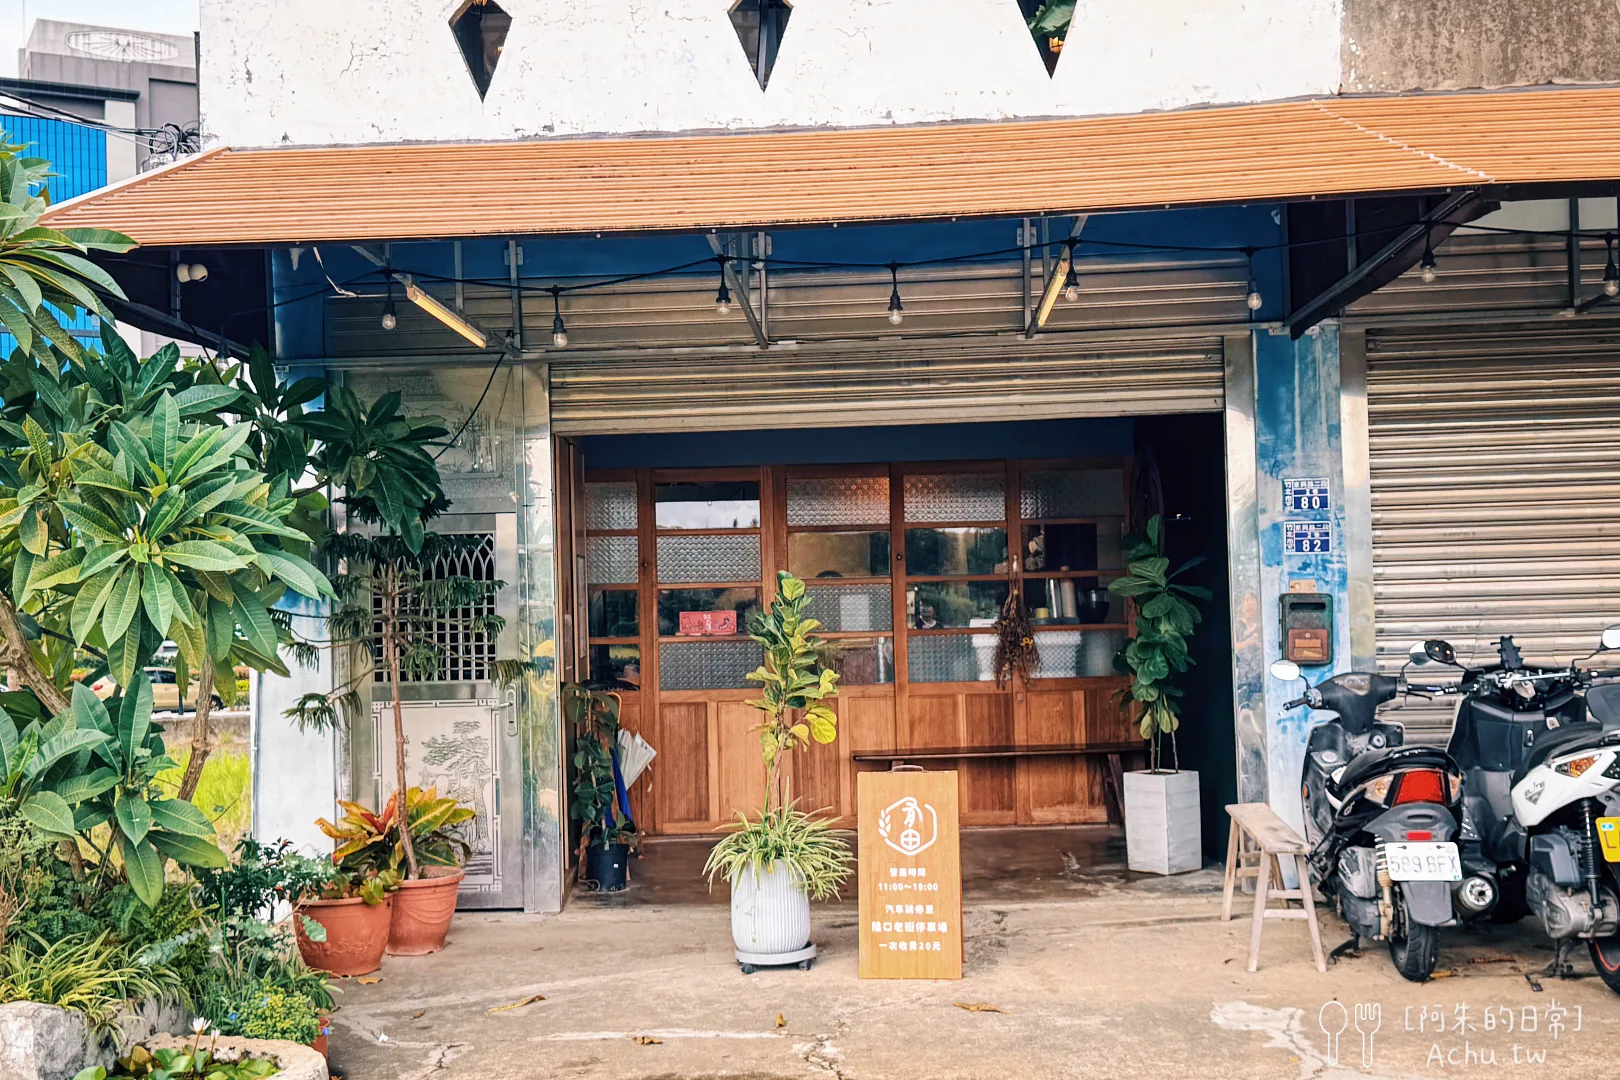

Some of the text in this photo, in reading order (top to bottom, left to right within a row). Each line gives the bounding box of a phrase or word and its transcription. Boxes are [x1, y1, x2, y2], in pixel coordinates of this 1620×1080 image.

[1301, 496, 1320, 509] 80
[1302, 539, 1322, 552] 82
[889, 867, 926, 877] 營業時間
[878, 940, 941, 951] 一次收費20元
